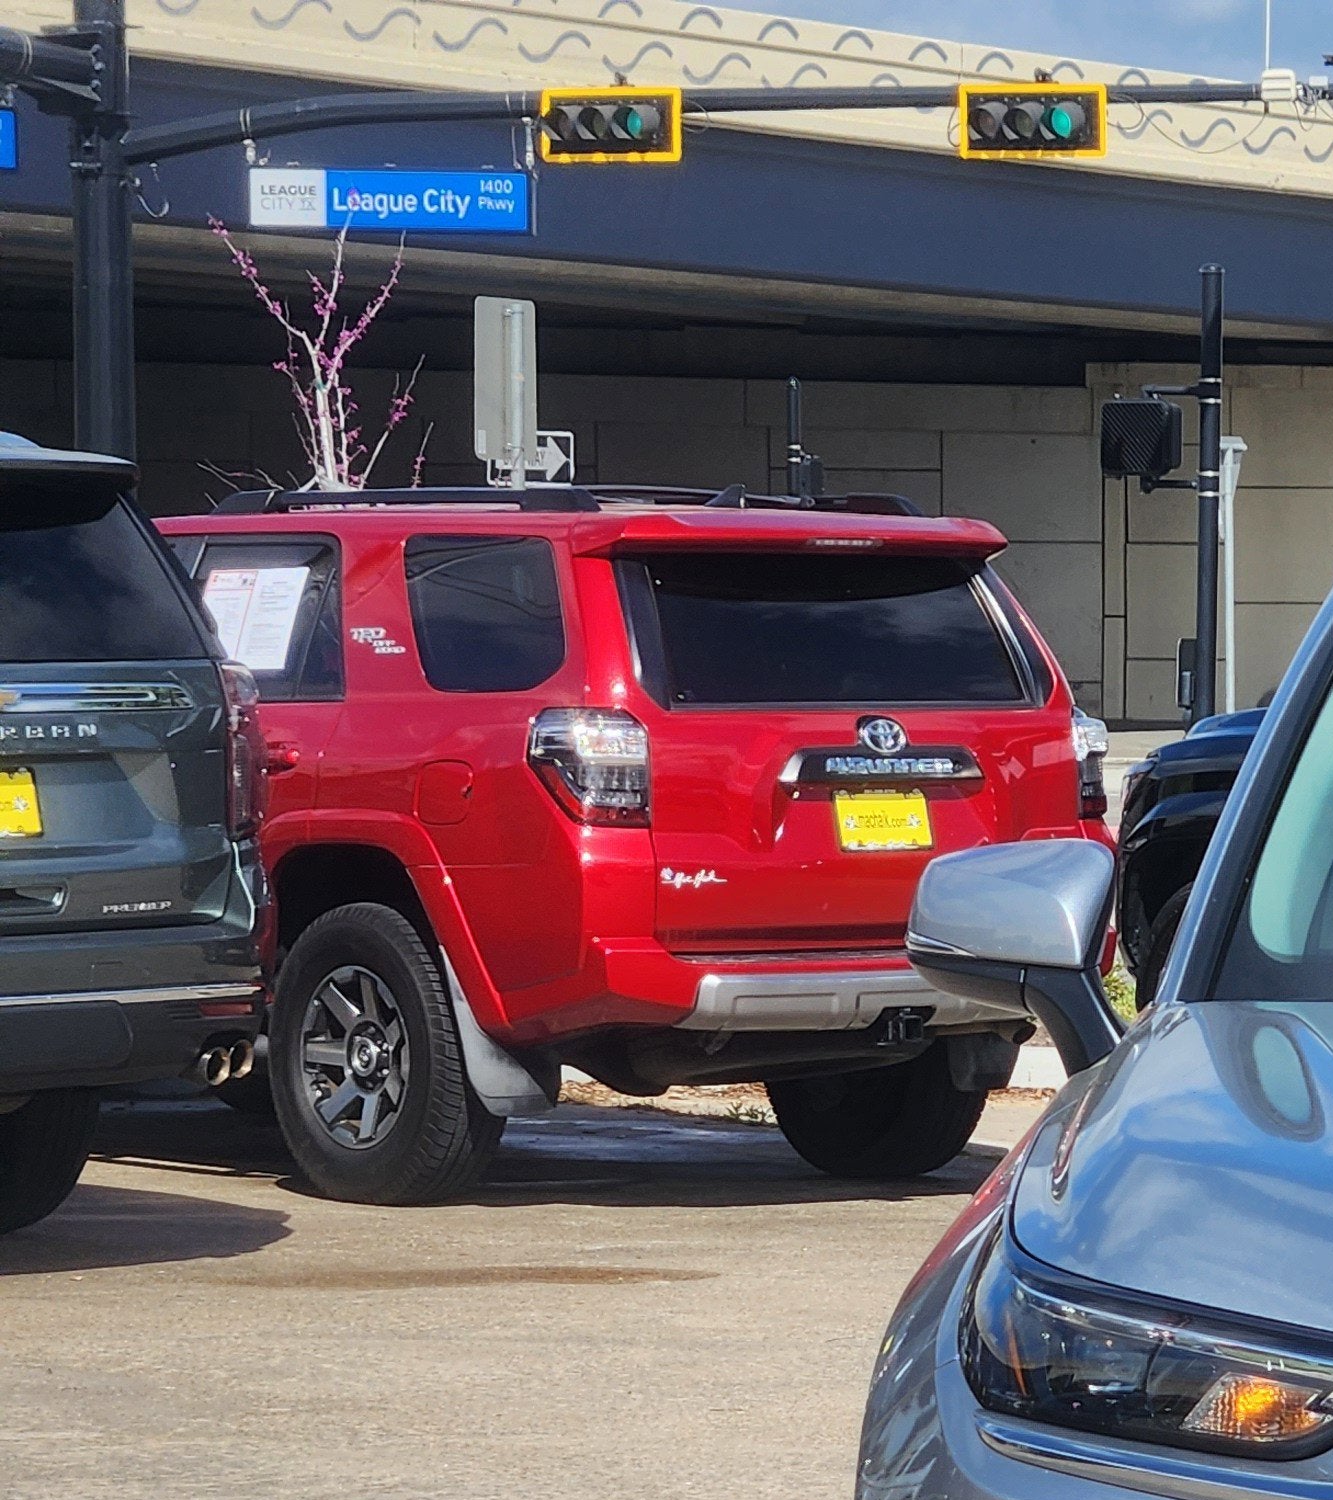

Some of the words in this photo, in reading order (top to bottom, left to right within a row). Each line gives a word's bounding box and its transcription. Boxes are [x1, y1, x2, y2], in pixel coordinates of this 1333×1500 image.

[261, 185, 316, 195] LEAGUE
[480, 179, 513, 194] 1400
[261, 197, 293, 210] CITY
[333, 187, 418, 219] League
[423, 188, 471, 219] City
[478, 196, 515, 213] Pkwy
[350, 627, 387, 643] TRD
[103, 901, 172, 913] PREMIER
